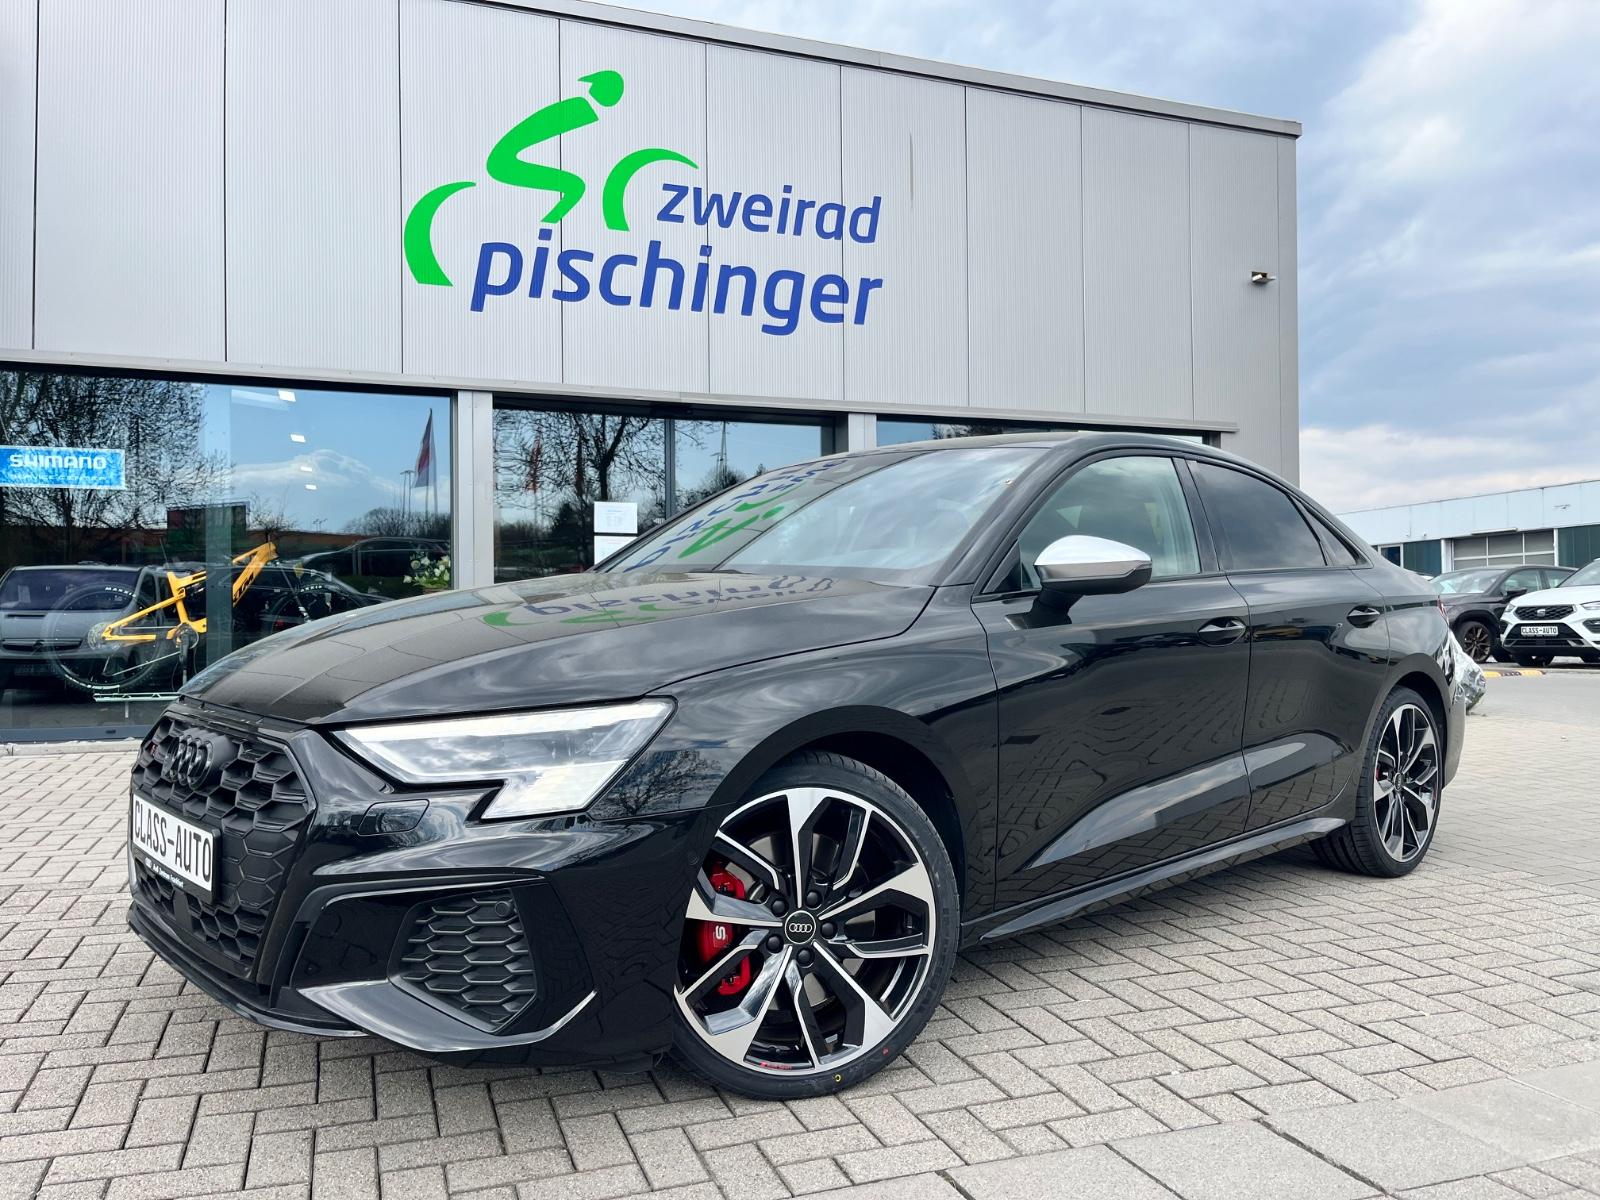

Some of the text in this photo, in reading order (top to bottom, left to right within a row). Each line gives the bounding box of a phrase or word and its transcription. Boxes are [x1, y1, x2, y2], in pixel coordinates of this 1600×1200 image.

[656, 183, 882, 243] zweirad
[470, 228, 883, 336] pischinger
[9, 454, 107, 470] SHIMANO
[134, 799, 212, 882] CLASS-AUTO
